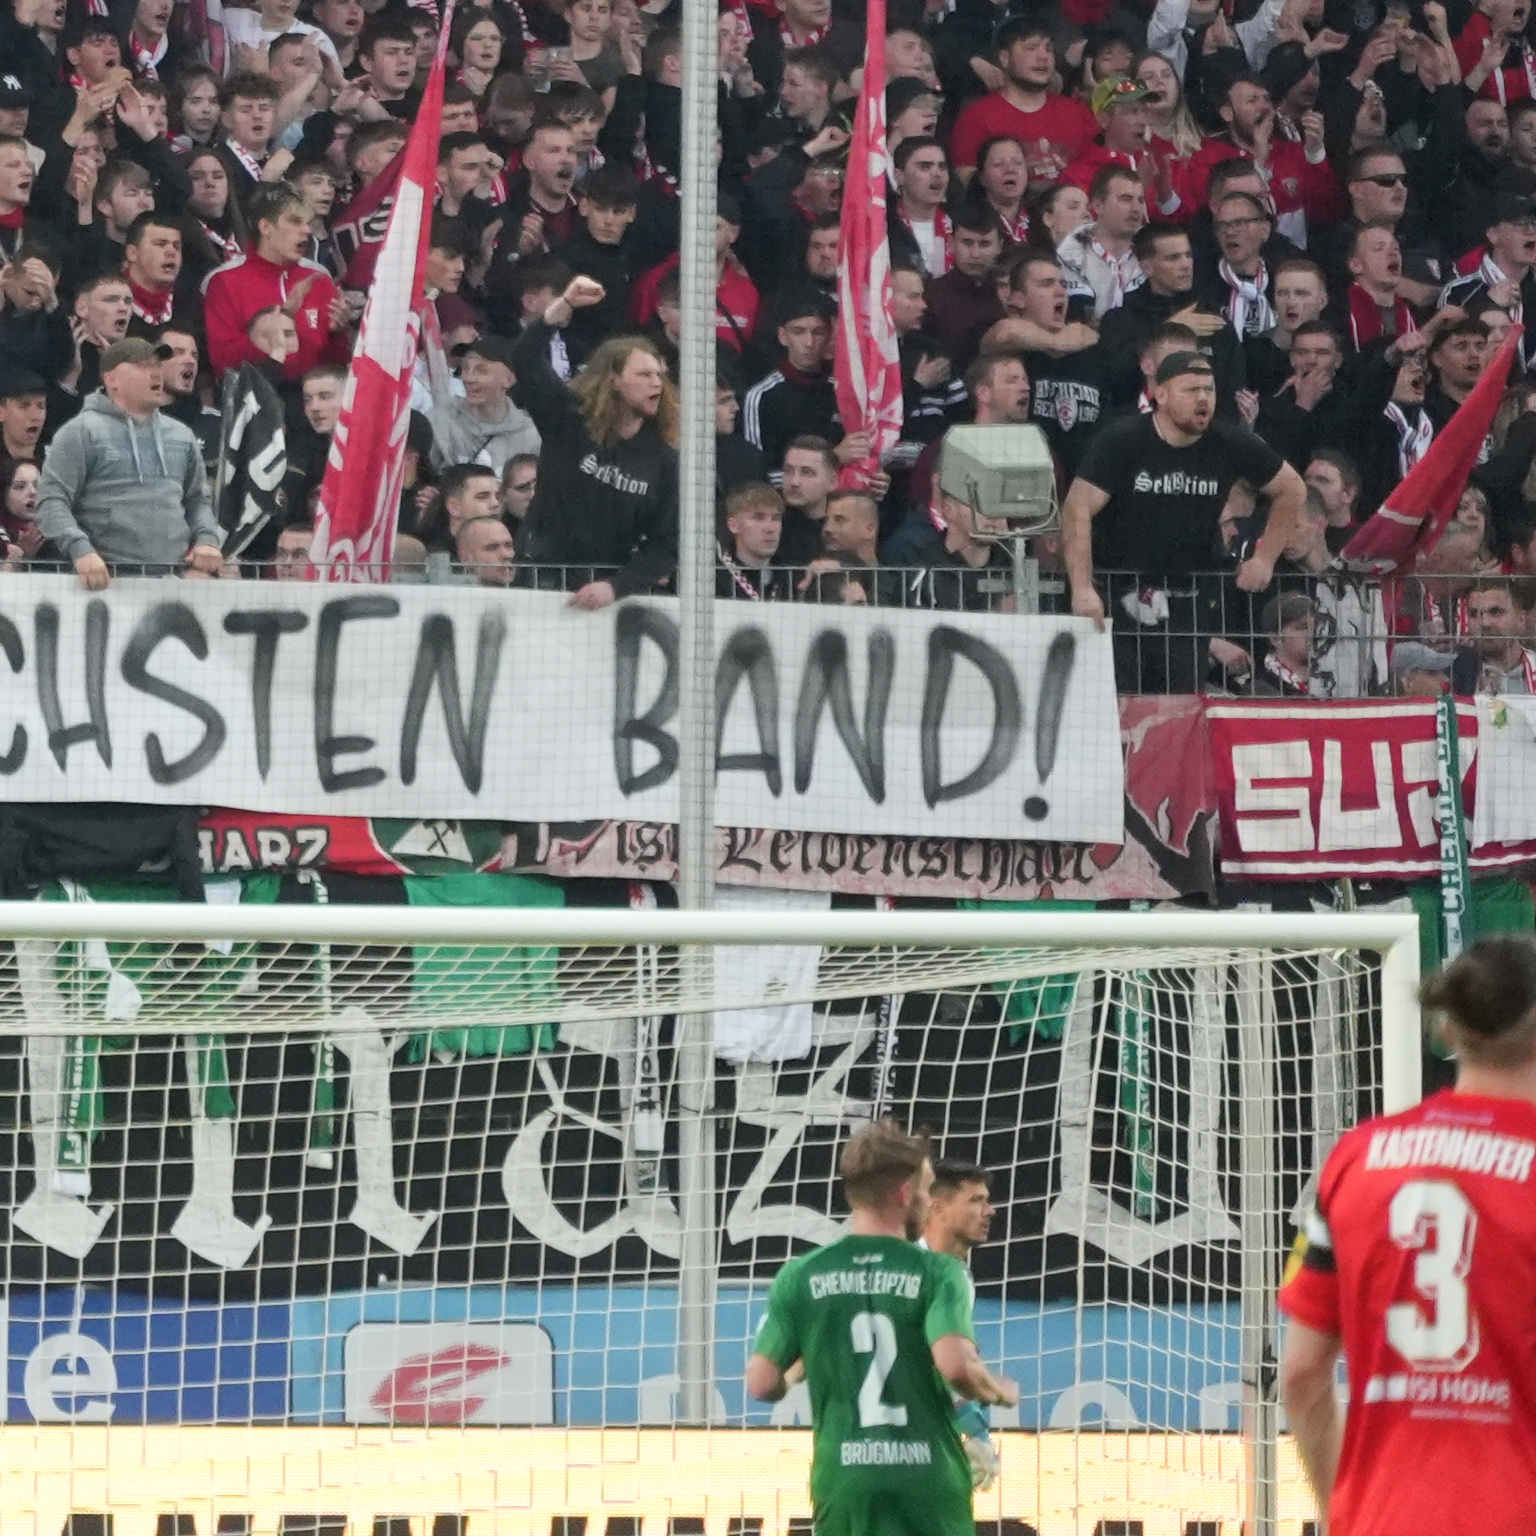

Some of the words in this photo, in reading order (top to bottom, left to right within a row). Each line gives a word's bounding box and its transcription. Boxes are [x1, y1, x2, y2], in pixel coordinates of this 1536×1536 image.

[613, 604, 1079, 822] BAND!
[1365, 1124, 1536, 1182] KASTENHOFER
[809, 1271, 868, 1300] CHEMIE
[1386, 1178, 1481, 1374] 3
[850, 1311, 908, 1428] 2
[840, 1438, 932, 1467] BRÜGMANN
